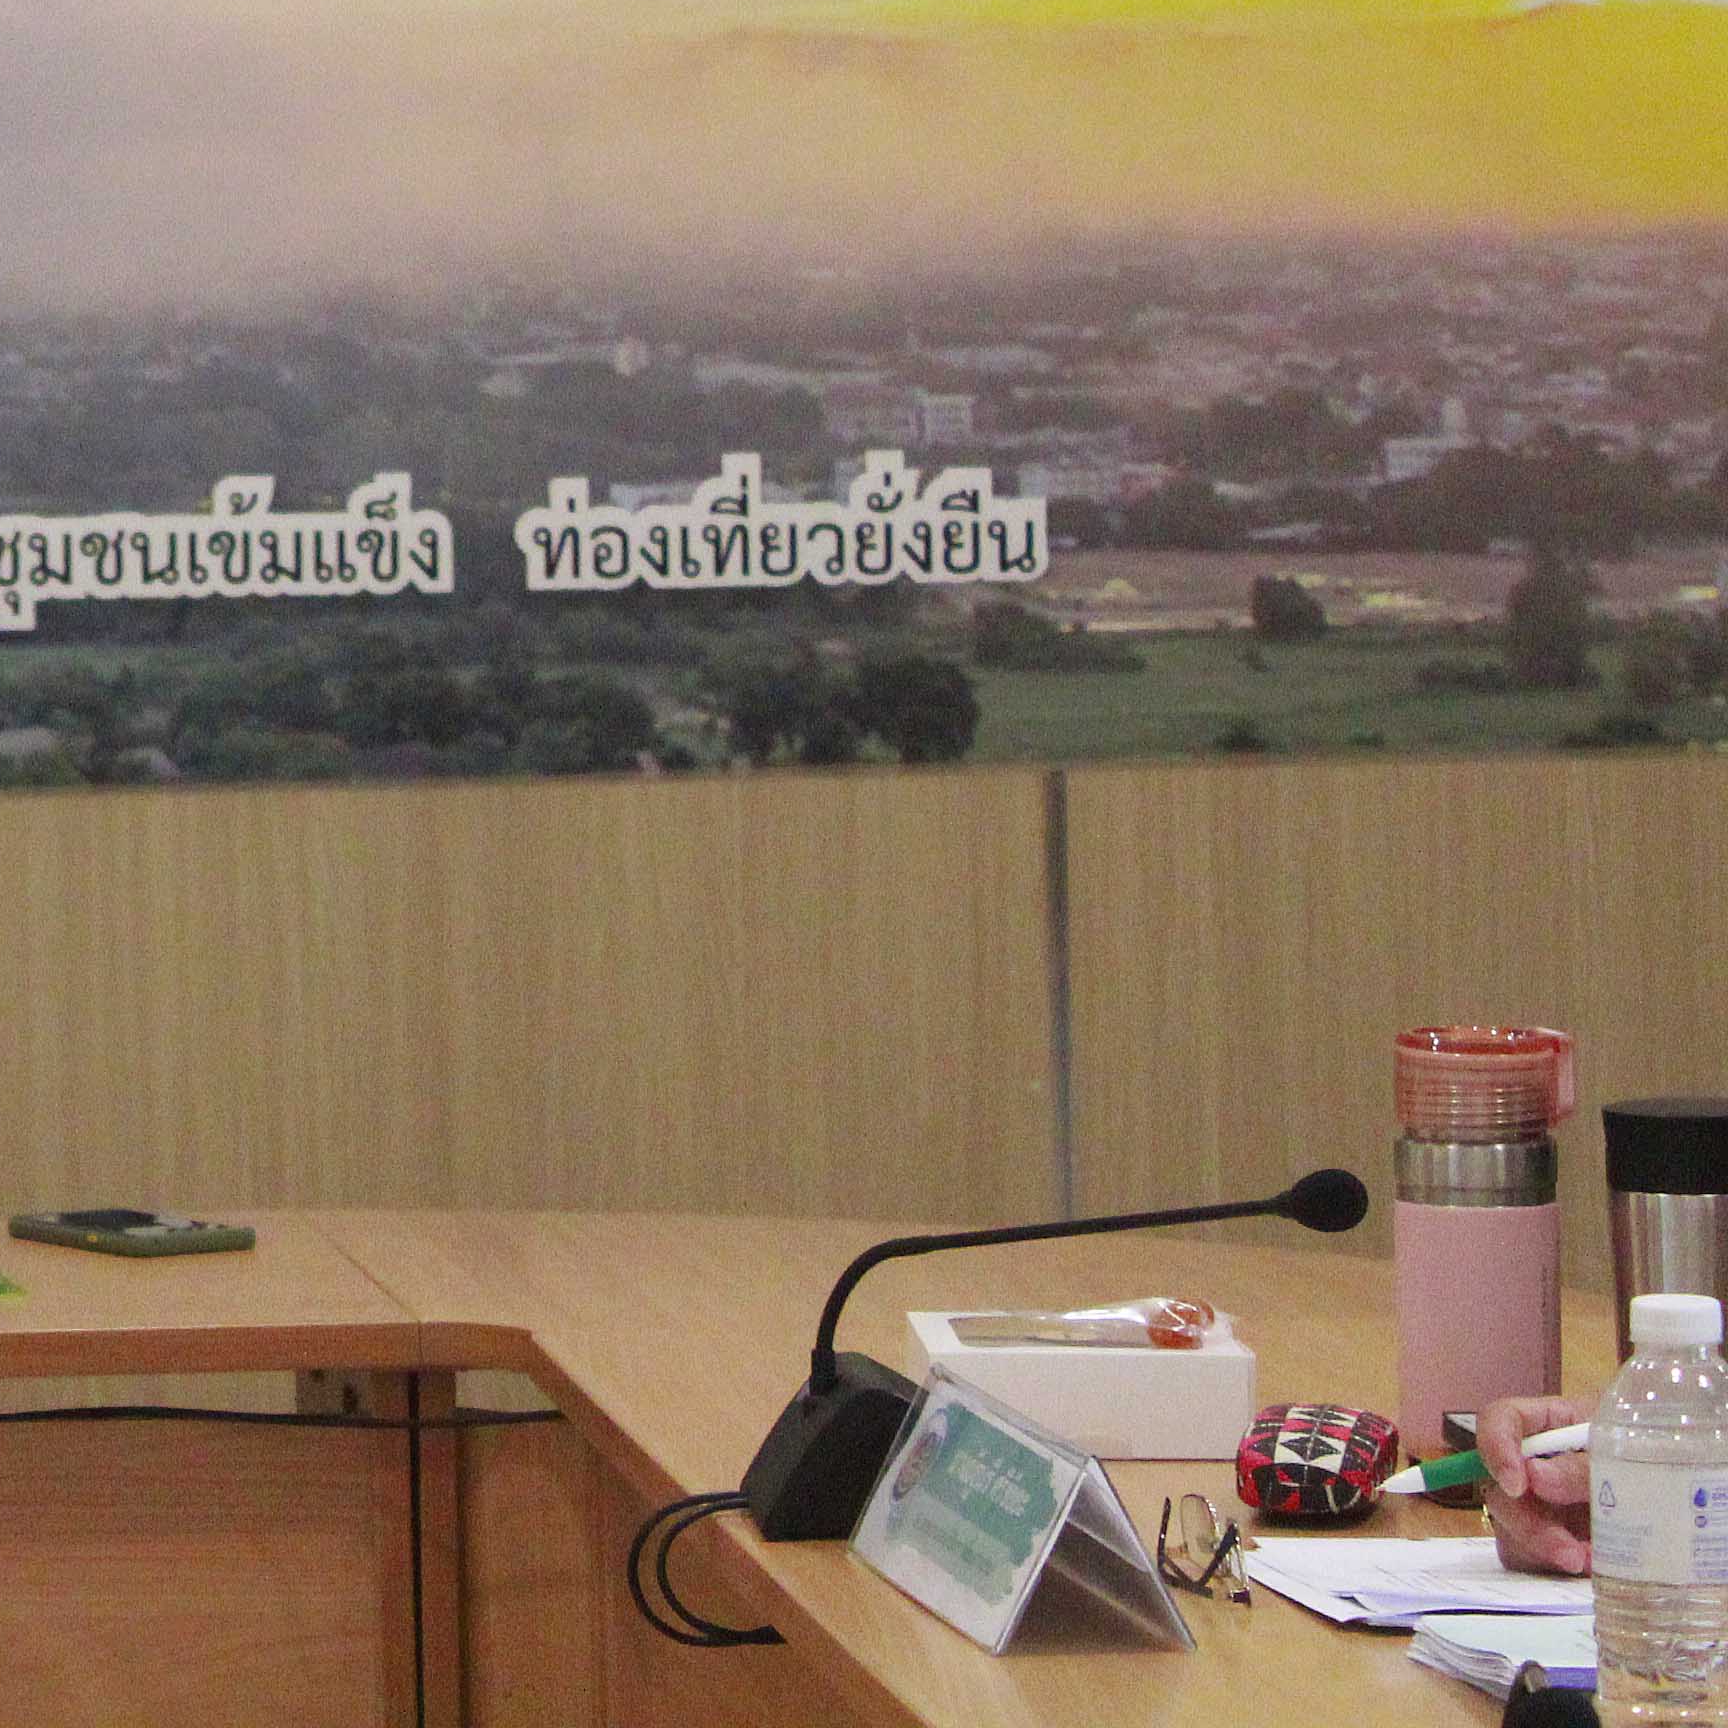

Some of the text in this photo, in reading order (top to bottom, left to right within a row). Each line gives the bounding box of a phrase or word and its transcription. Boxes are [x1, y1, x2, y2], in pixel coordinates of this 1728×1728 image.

[531, 470, 1038, 579] ท่องเที่ยวยั่งยืน
